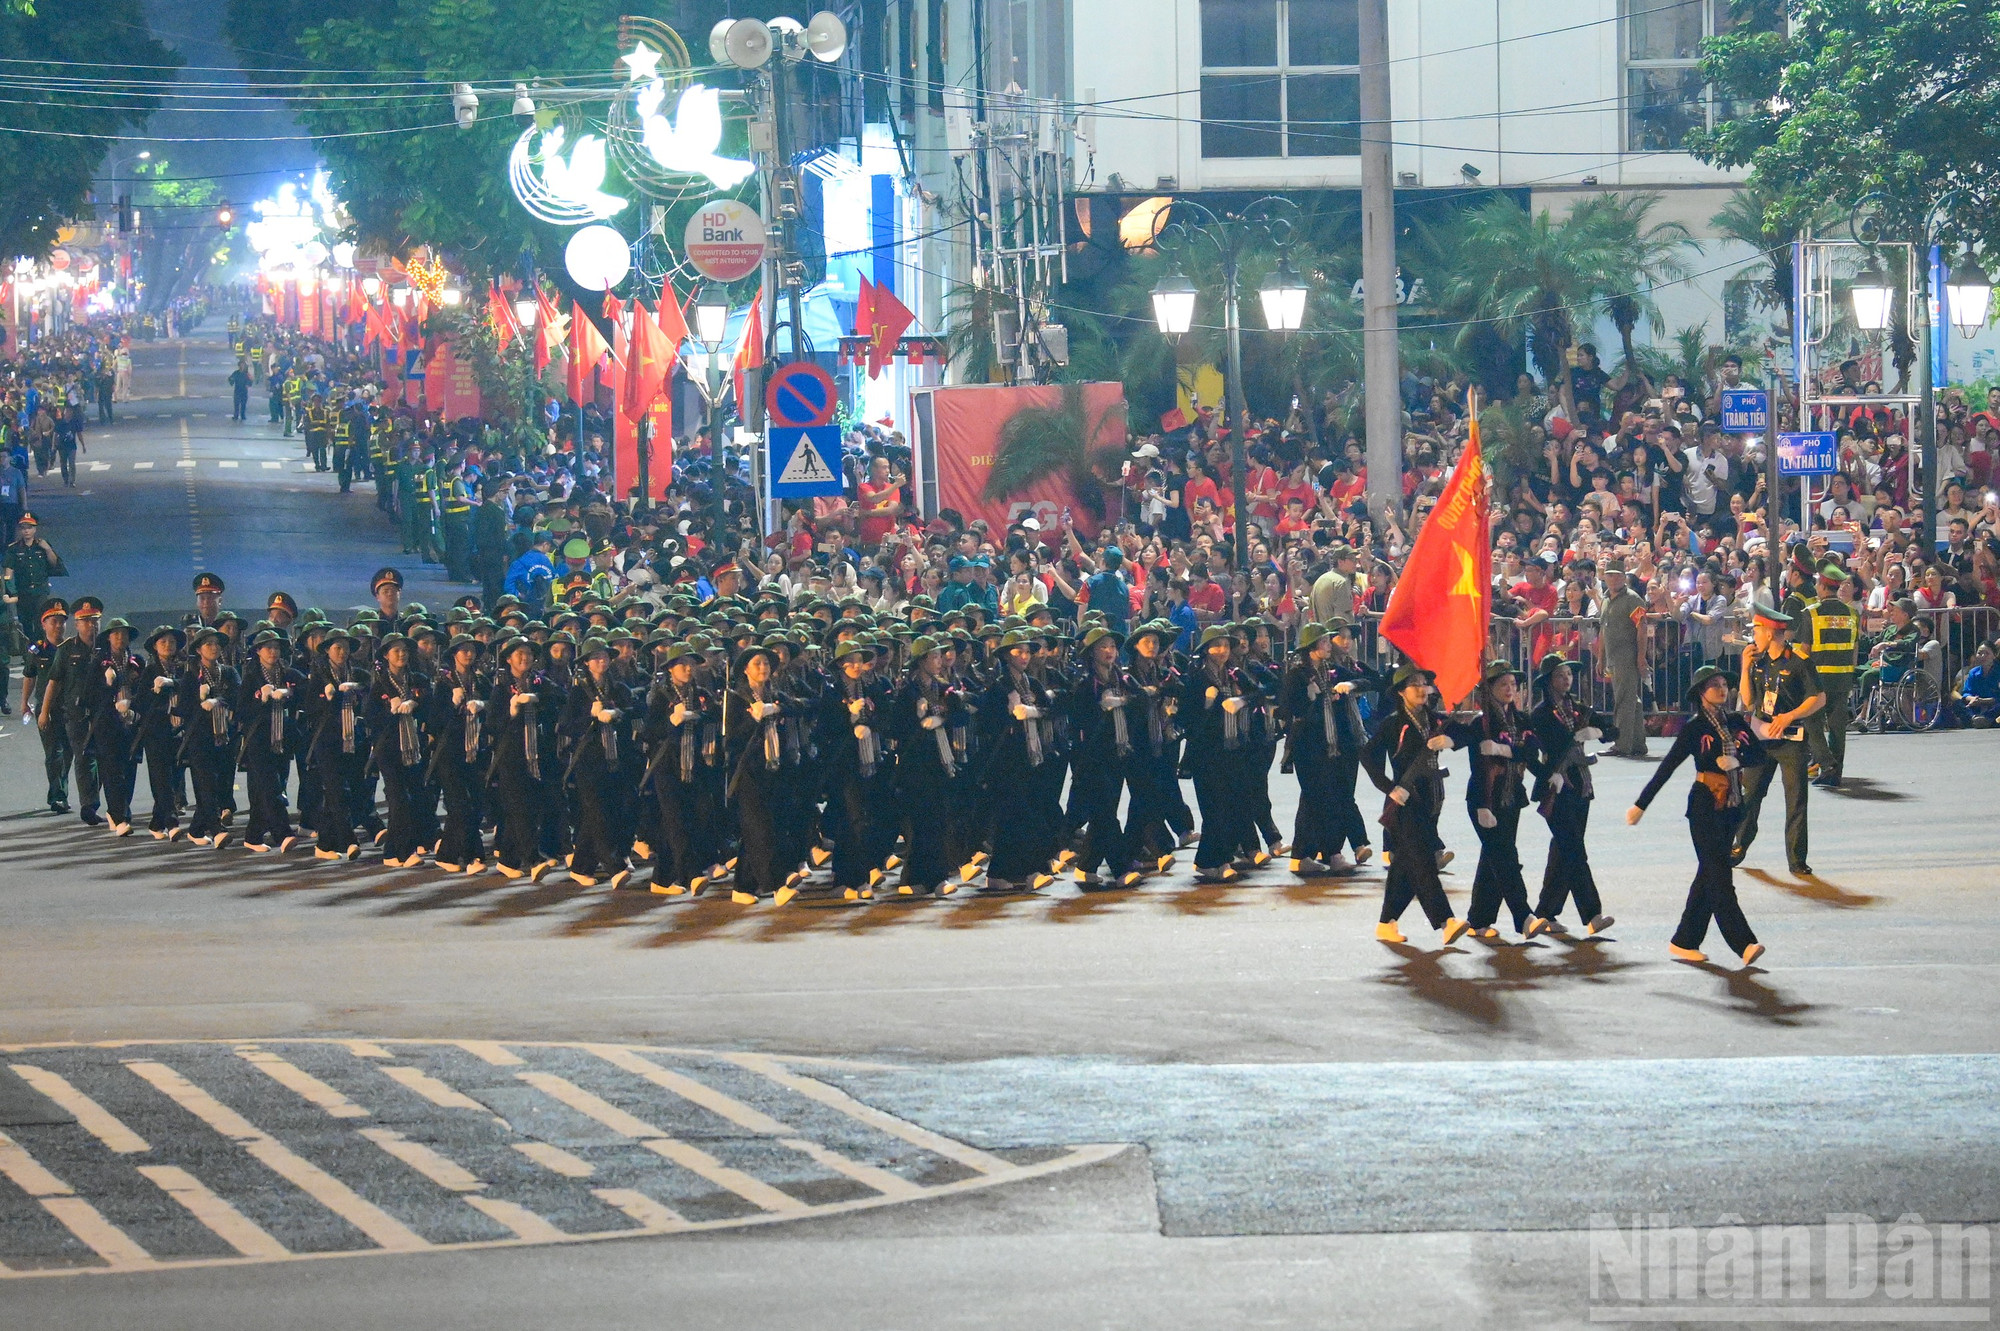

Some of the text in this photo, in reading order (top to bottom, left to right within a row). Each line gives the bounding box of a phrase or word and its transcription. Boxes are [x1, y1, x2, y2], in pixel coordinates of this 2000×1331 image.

[703, 213, 726, 227] HD
[703, 228, 744, 242] Bank
[1742, 395, 1757, 405] PHỐ
[1725, 408, 1749, 426] TRÀNG
[1802, 436, 1820, 447] PHỐ
[1796, 451, 1818, 469] THÁI
[1820, 447, 1832, 468] TỔ
